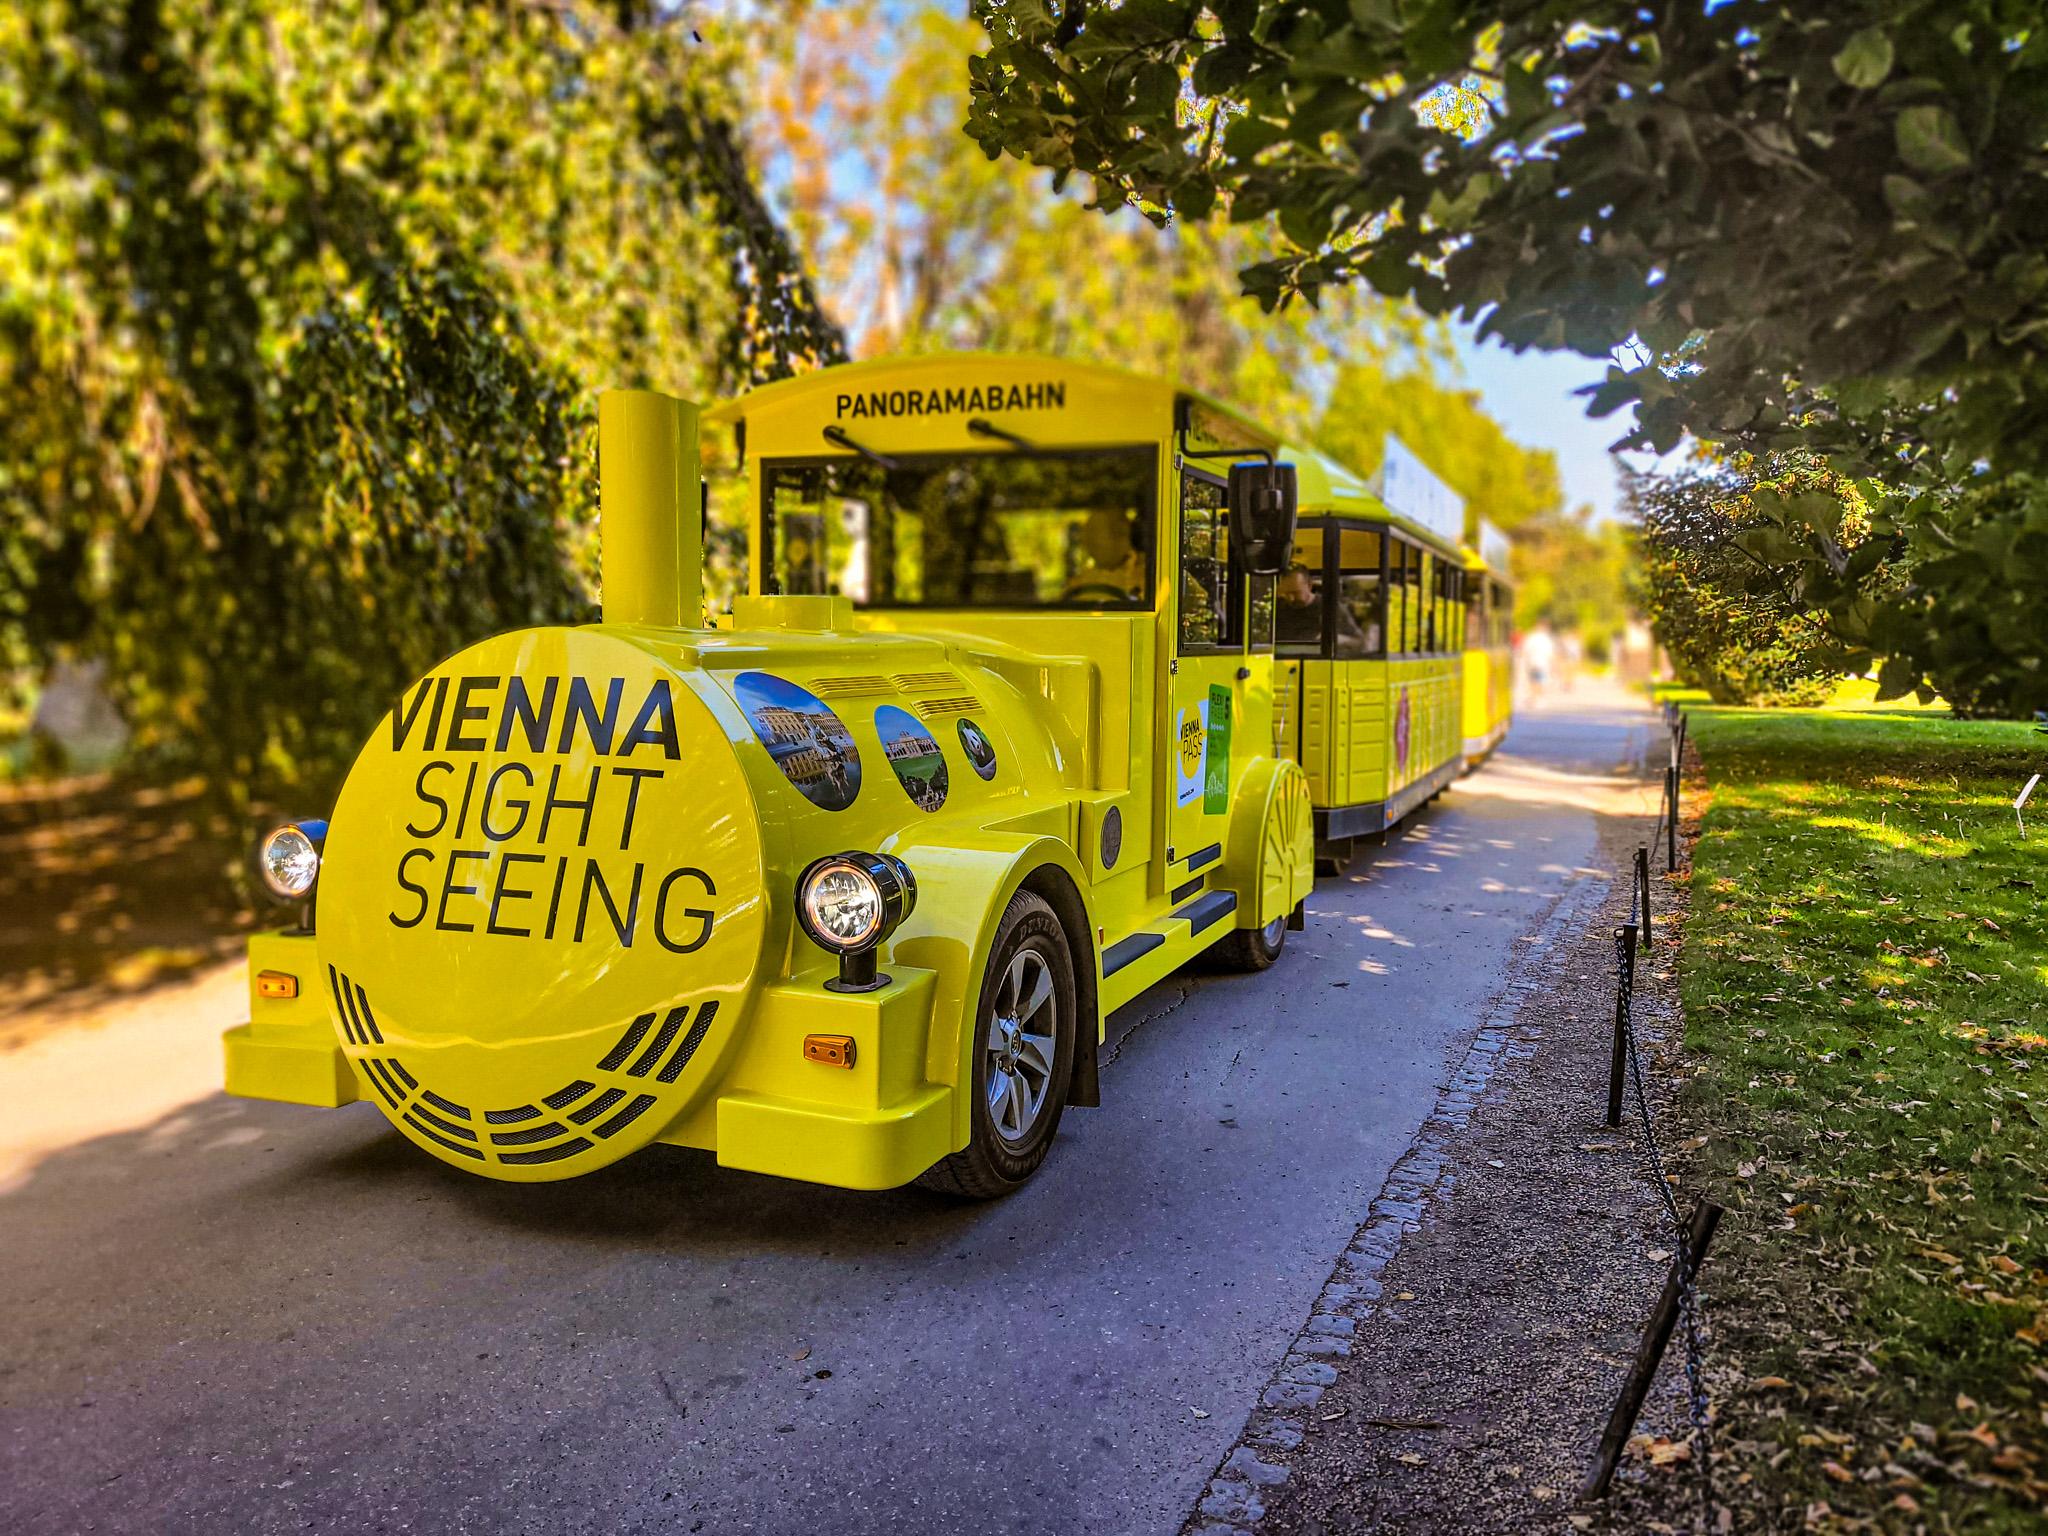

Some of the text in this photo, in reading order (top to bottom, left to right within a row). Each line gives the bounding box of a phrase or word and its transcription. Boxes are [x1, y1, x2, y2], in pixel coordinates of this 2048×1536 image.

[836, 381, 1066, 419] PANORAMABAHN
[391, 675, 681, 761] VIENNA
[1180, 718, 1200, 741] VIENNA
[1183, 732, 1202, 764] PASS
[405, 760, 664, 851] SIGHT
[388, 848, 717, 954] SEEING
